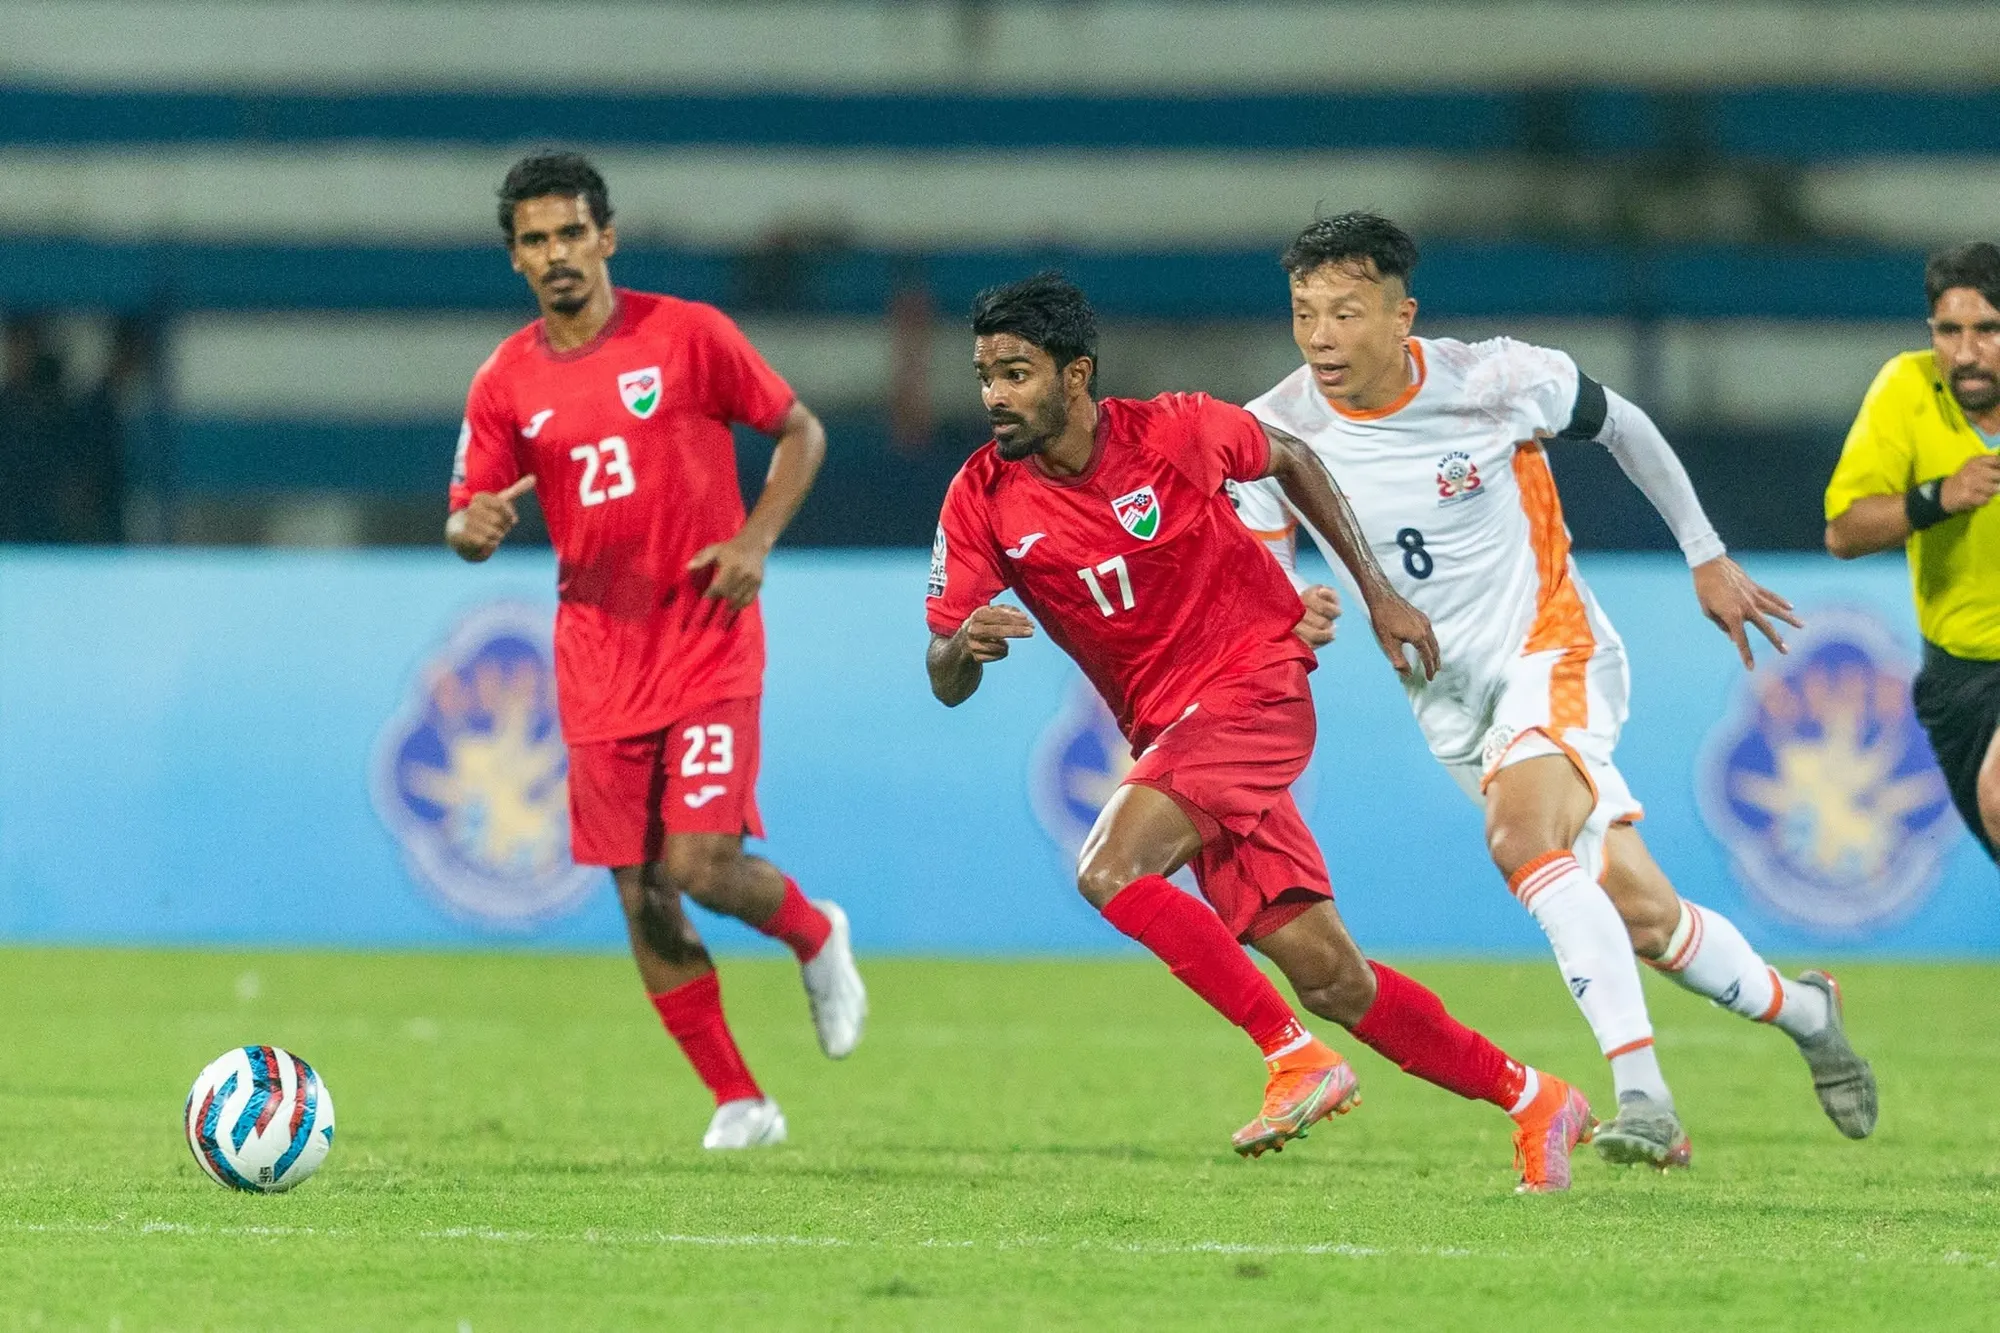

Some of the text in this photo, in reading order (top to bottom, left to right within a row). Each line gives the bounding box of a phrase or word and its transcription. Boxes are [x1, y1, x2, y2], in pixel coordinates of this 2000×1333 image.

[570, 436, 636, 507] 23
[1396, 527, 1434, 580] 8
[1077, 555, 1136, 618] 17
[680, 723, 734, 778] 23
